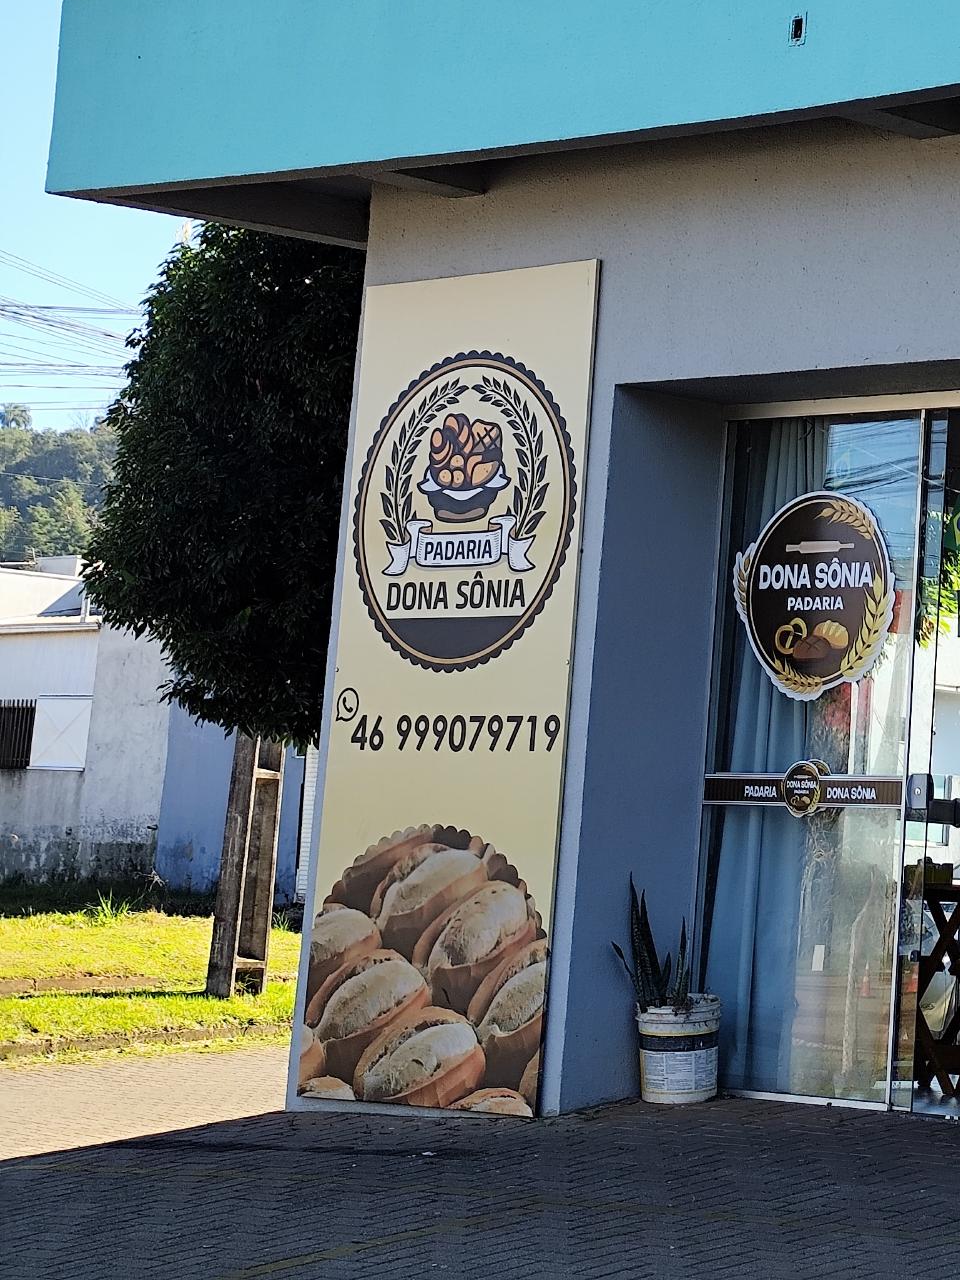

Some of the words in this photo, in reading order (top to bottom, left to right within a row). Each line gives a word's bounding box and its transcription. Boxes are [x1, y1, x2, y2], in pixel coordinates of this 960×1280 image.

[424, 539, 493, 561] PADARIA
[758, 564, 812, 590] DONA
[814, 558, 874, 589] SÔNIA
[386, 580, 449, 611] DONA
[455, 571, 526, 609] SÔNIA
[787, 595, 844, 611] PADARIA
[350, 715, 384, 752] 46
[396, 714, 561, 753] 999079719
[744, 785, 777, 798] PADARIA
[786, 780, 800, 789] DONA
[826, 786, 850, 799] DONA
[850, 785, 876, 799] SÔNIA
